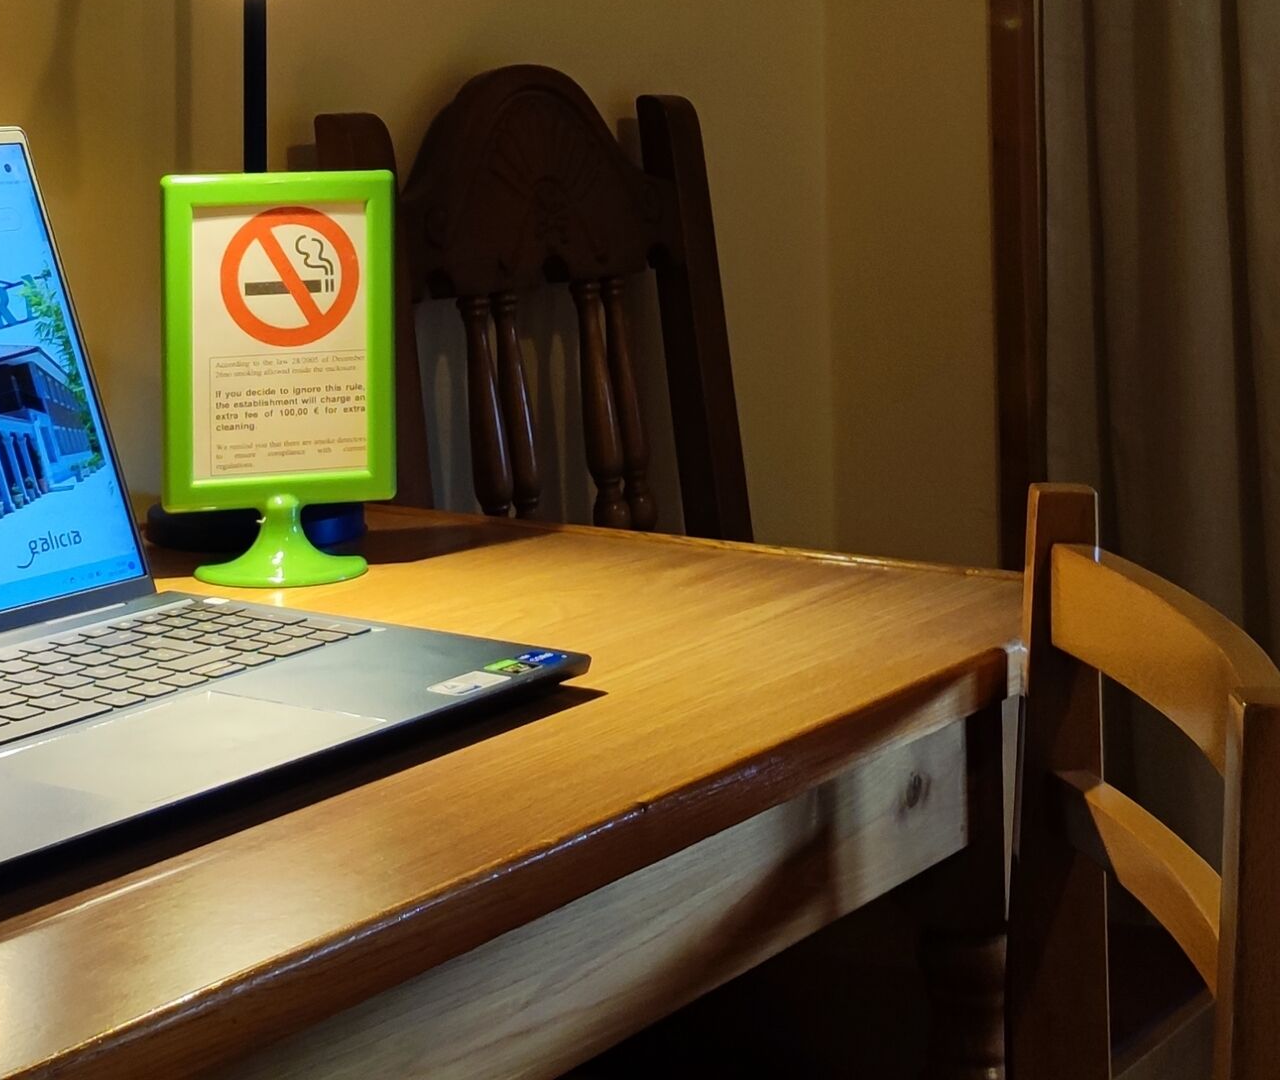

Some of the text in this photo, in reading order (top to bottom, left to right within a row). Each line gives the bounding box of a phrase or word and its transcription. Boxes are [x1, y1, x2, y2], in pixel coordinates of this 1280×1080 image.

[263, 358, 273, 366] the
[321, 355, 329, 363] of
[215, 390, 222, 399] If
[225, 391, 242, 400] you
[245, 387, 276, 397] decide
[280, 387, 289, 395] to
[293, 385, 321, 396] ignore
[325, 383, 342, 392] this
[215, 394, 366, 409] the establishment will charge an
[215, 412, 238, 421] extra
[245, 410, 258, 419] fee
[264, 410, 273, 418] of
[313, 406, 320, 415] €
[324, 405, 337, 414] for
[343, 405, 366, 413] extra
[17, 529, 83, 569] galicia
